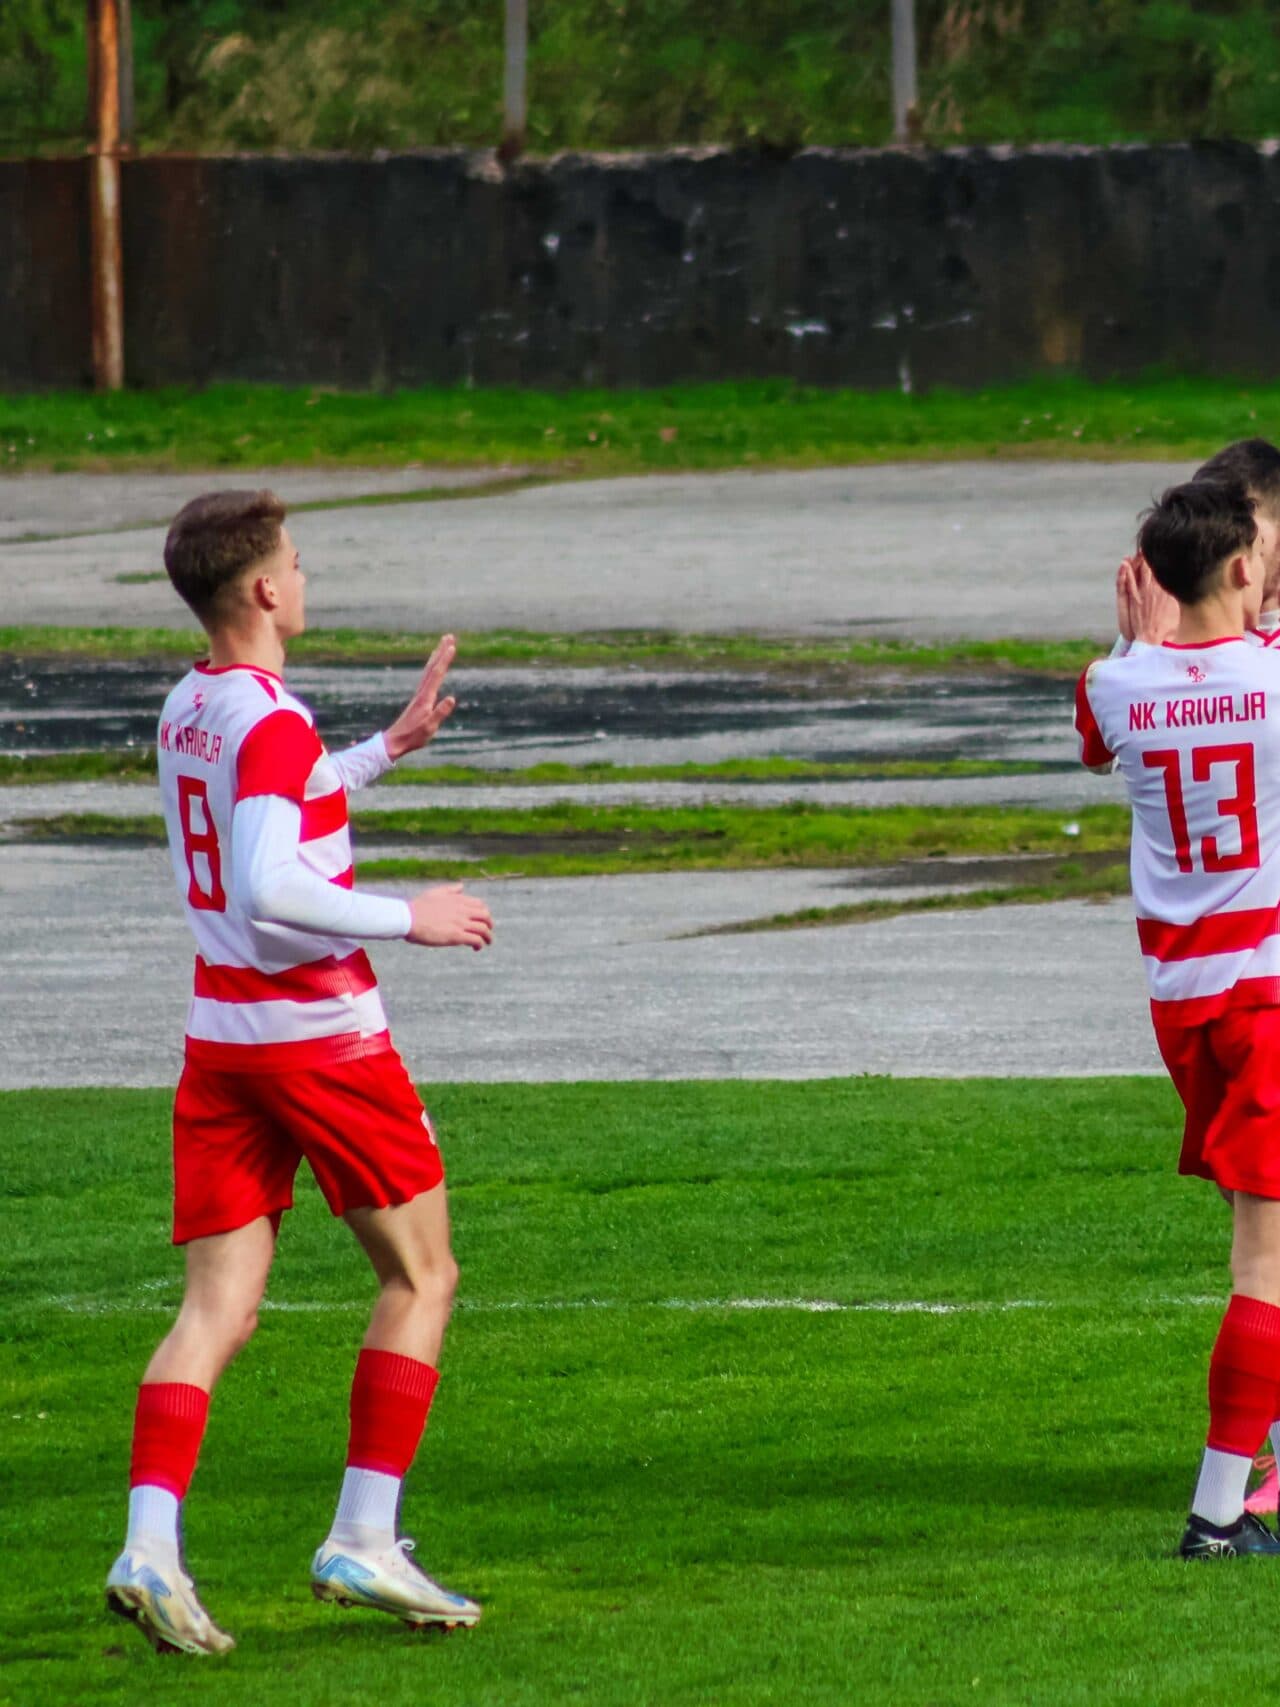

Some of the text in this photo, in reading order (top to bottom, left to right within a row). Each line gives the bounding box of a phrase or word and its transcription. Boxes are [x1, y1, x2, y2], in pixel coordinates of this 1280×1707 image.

[175, 725, 222, 765] KRIVAJA
[1129, 691, 1265, 731] NK KRIVAJA
[177, 775, 226, 913] 8
[1142, 743, 1260, 873] 13
